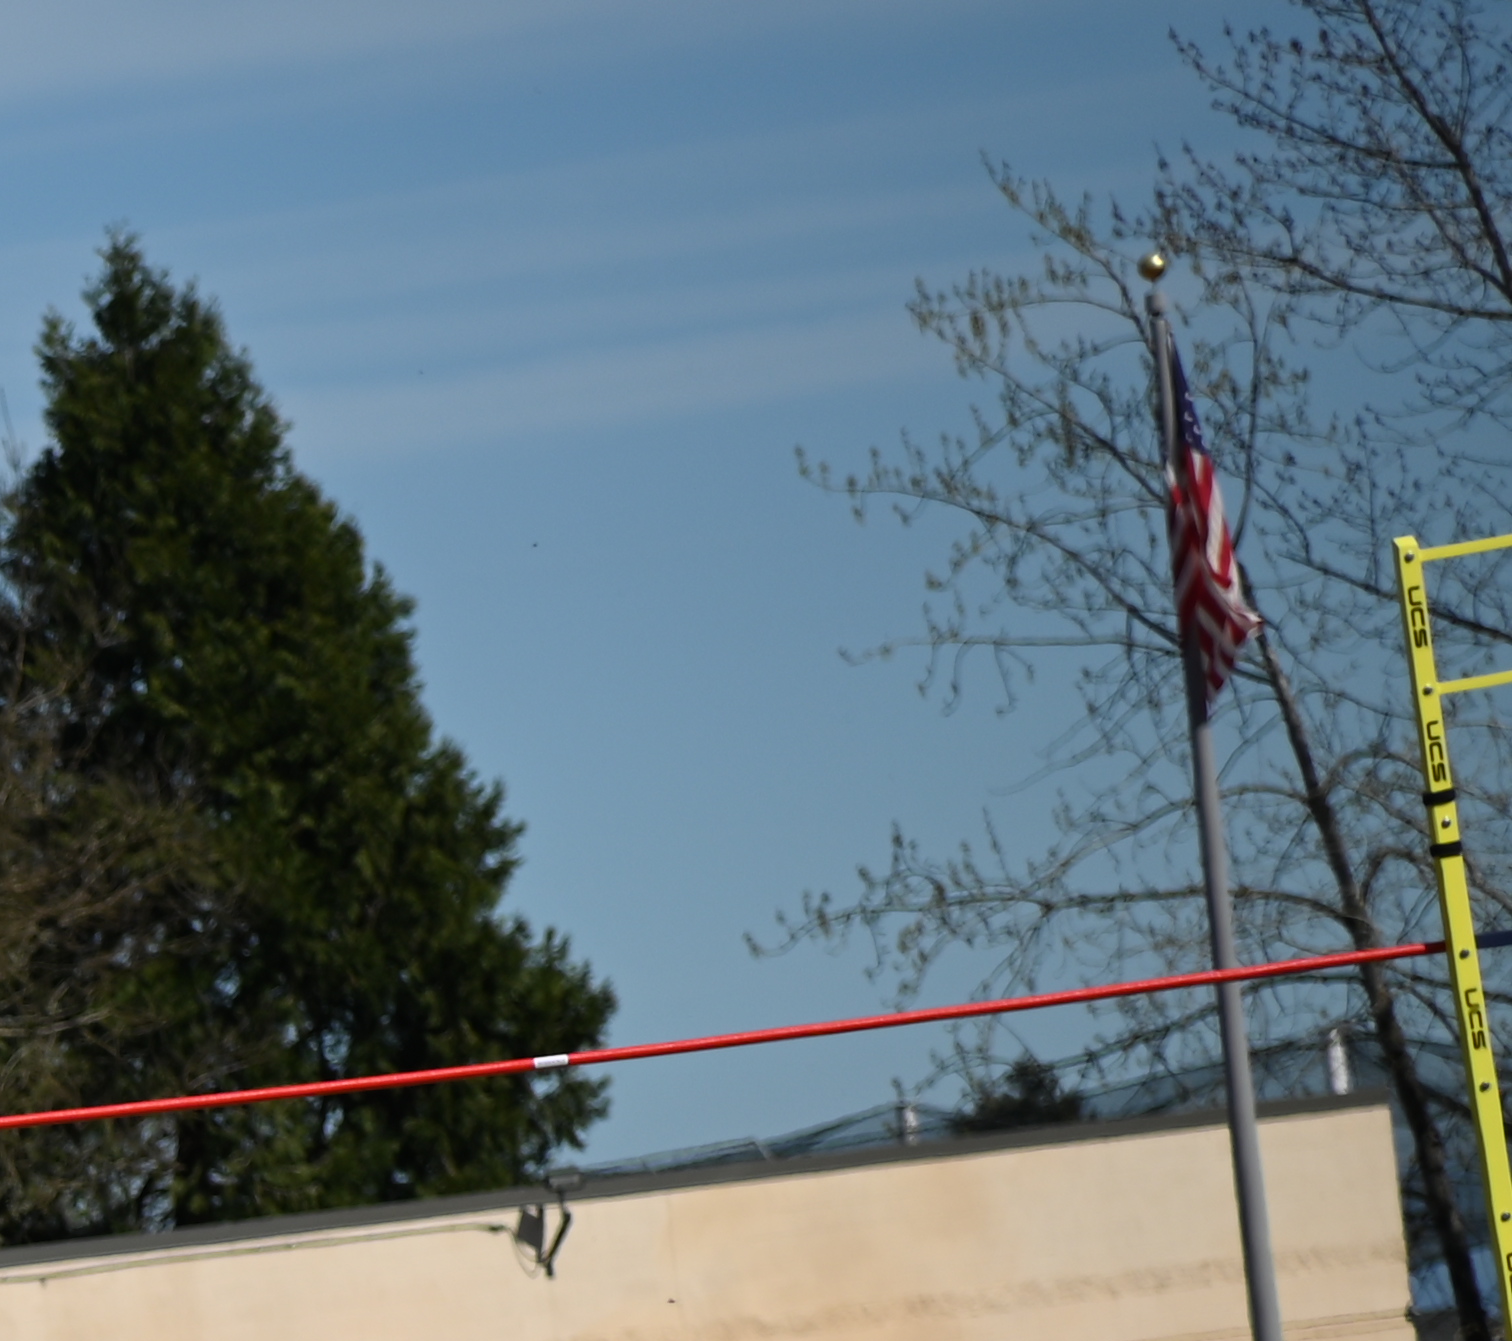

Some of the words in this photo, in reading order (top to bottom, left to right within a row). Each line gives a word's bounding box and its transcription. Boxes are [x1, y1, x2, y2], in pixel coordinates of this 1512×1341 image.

[1407, 584, 1428, 649] UCS
[1426, 720, 1445, 782] UCS
[1464, 988, 1487, 1050] UCS
